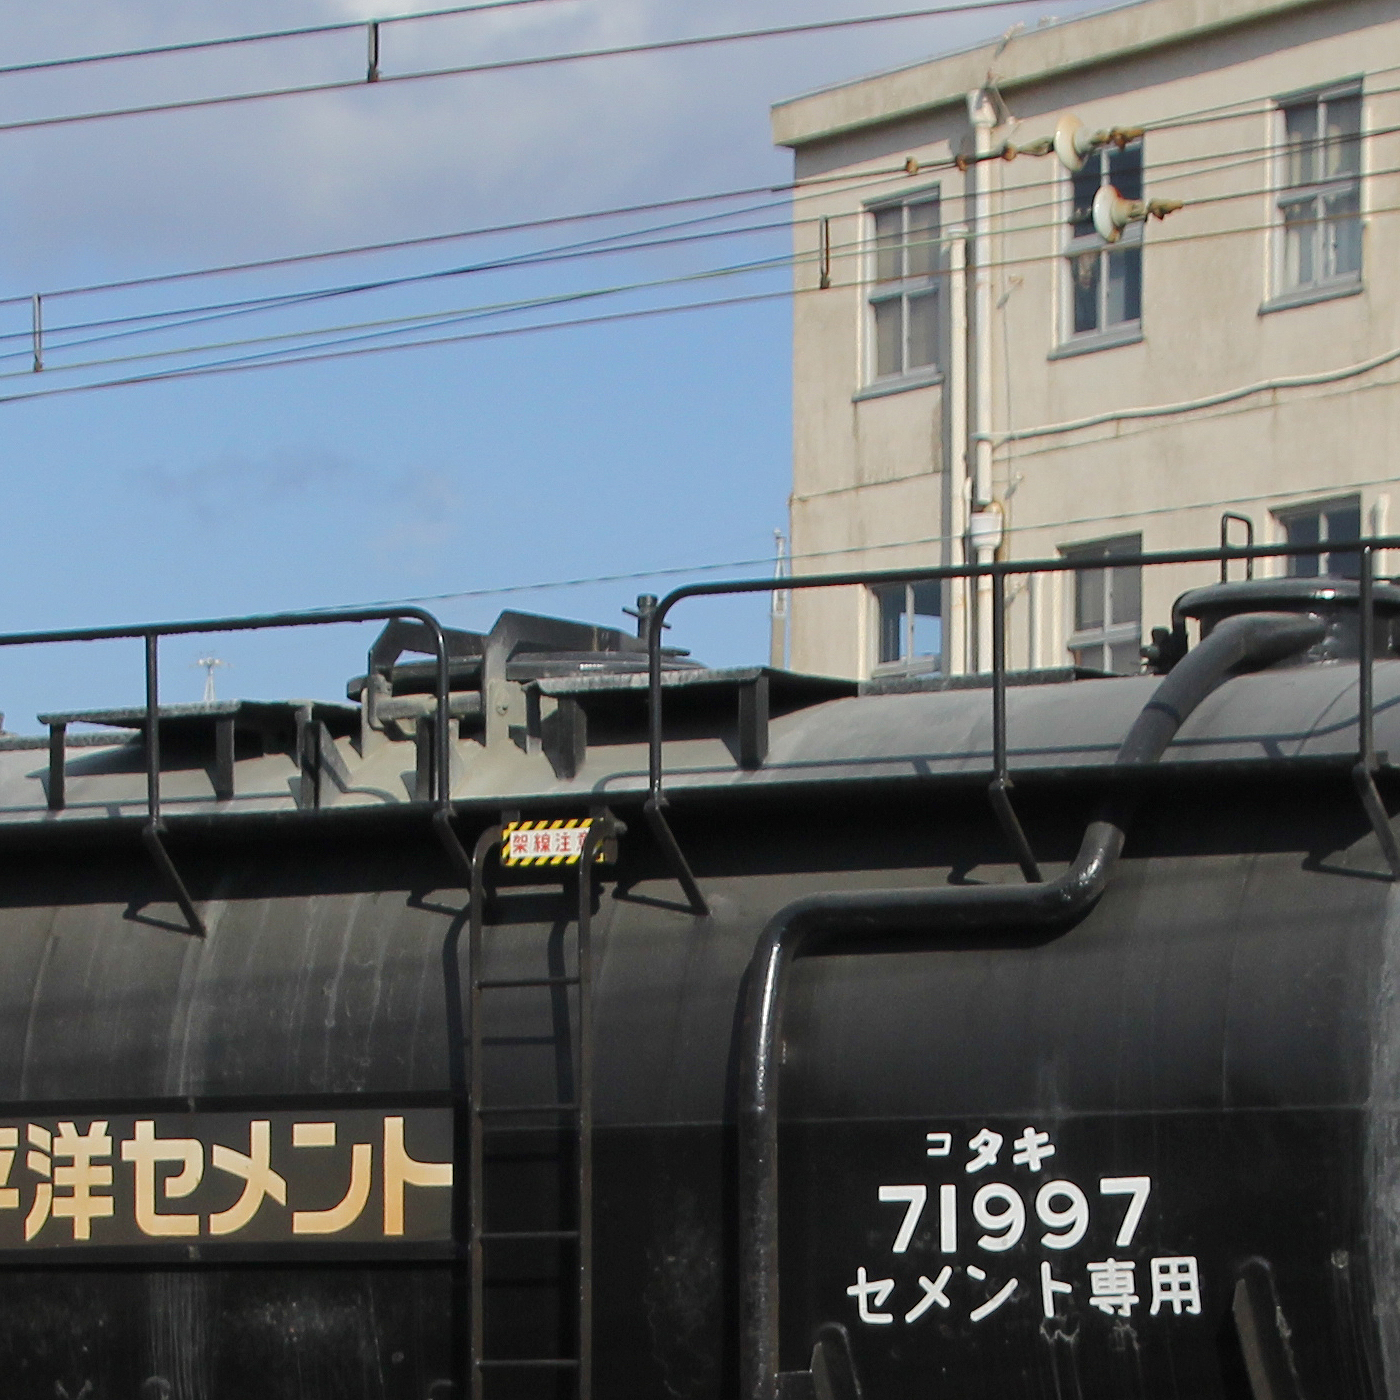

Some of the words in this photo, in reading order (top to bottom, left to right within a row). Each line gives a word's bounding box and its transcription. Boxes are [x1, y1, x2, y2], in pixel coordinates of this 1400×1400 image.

[926, 1126, 1056, 1173] コタキ
[878, 1176, 1151, 1253] 71997
[846, 1256, 1202, 1324] セメント専用
